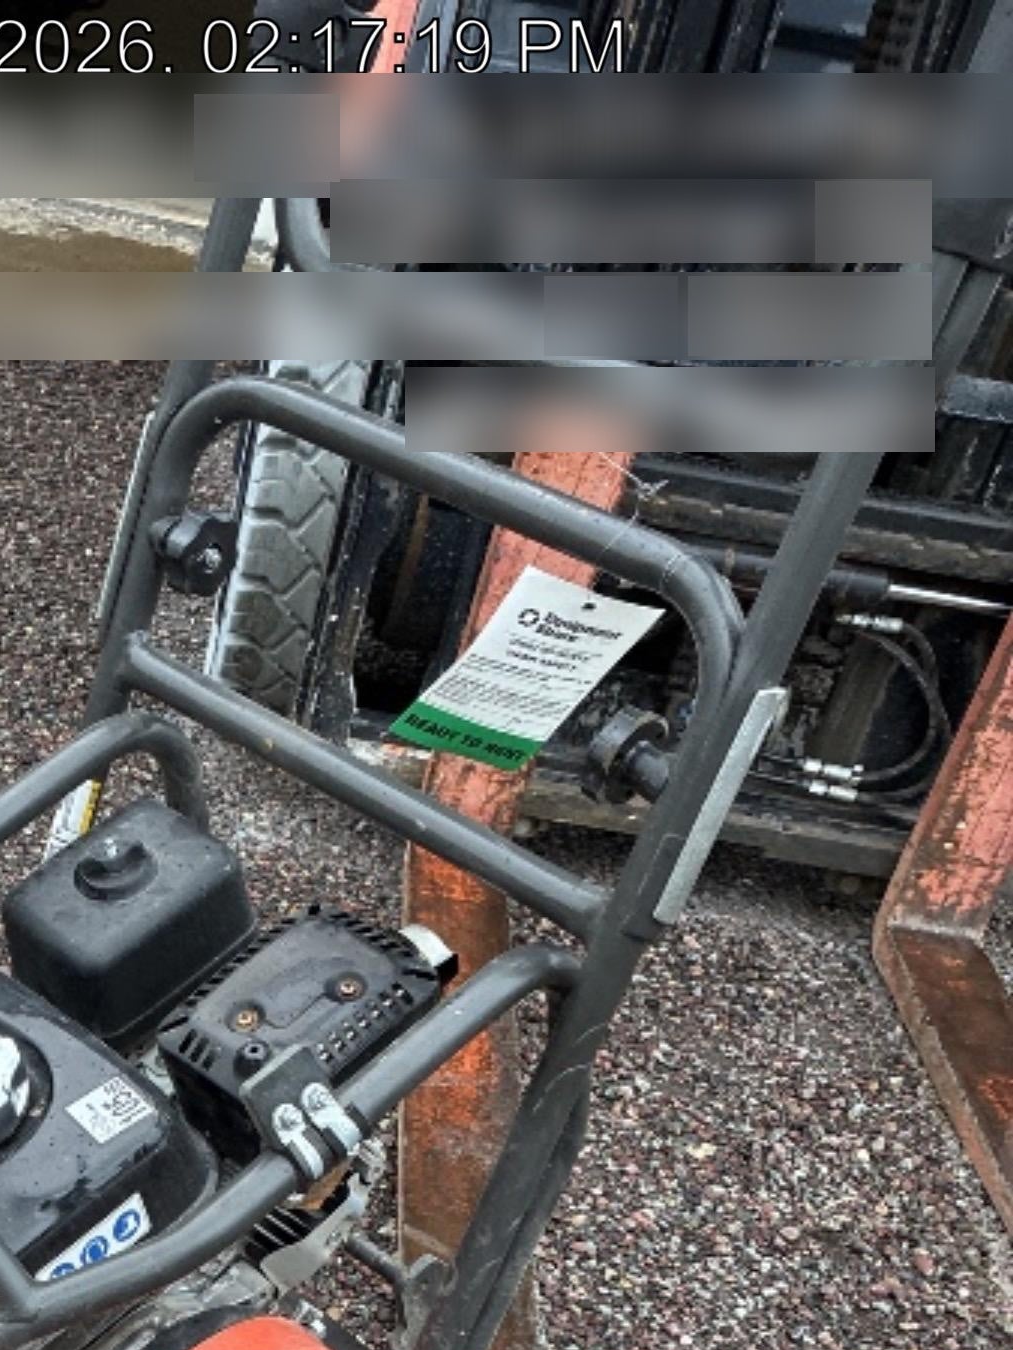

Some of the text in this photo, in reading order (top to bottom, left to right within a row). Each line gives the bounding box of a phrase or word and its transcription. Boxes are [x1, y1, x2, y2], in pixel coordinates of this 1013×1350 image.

[405, 713, 526, 761] READY TO RENT
